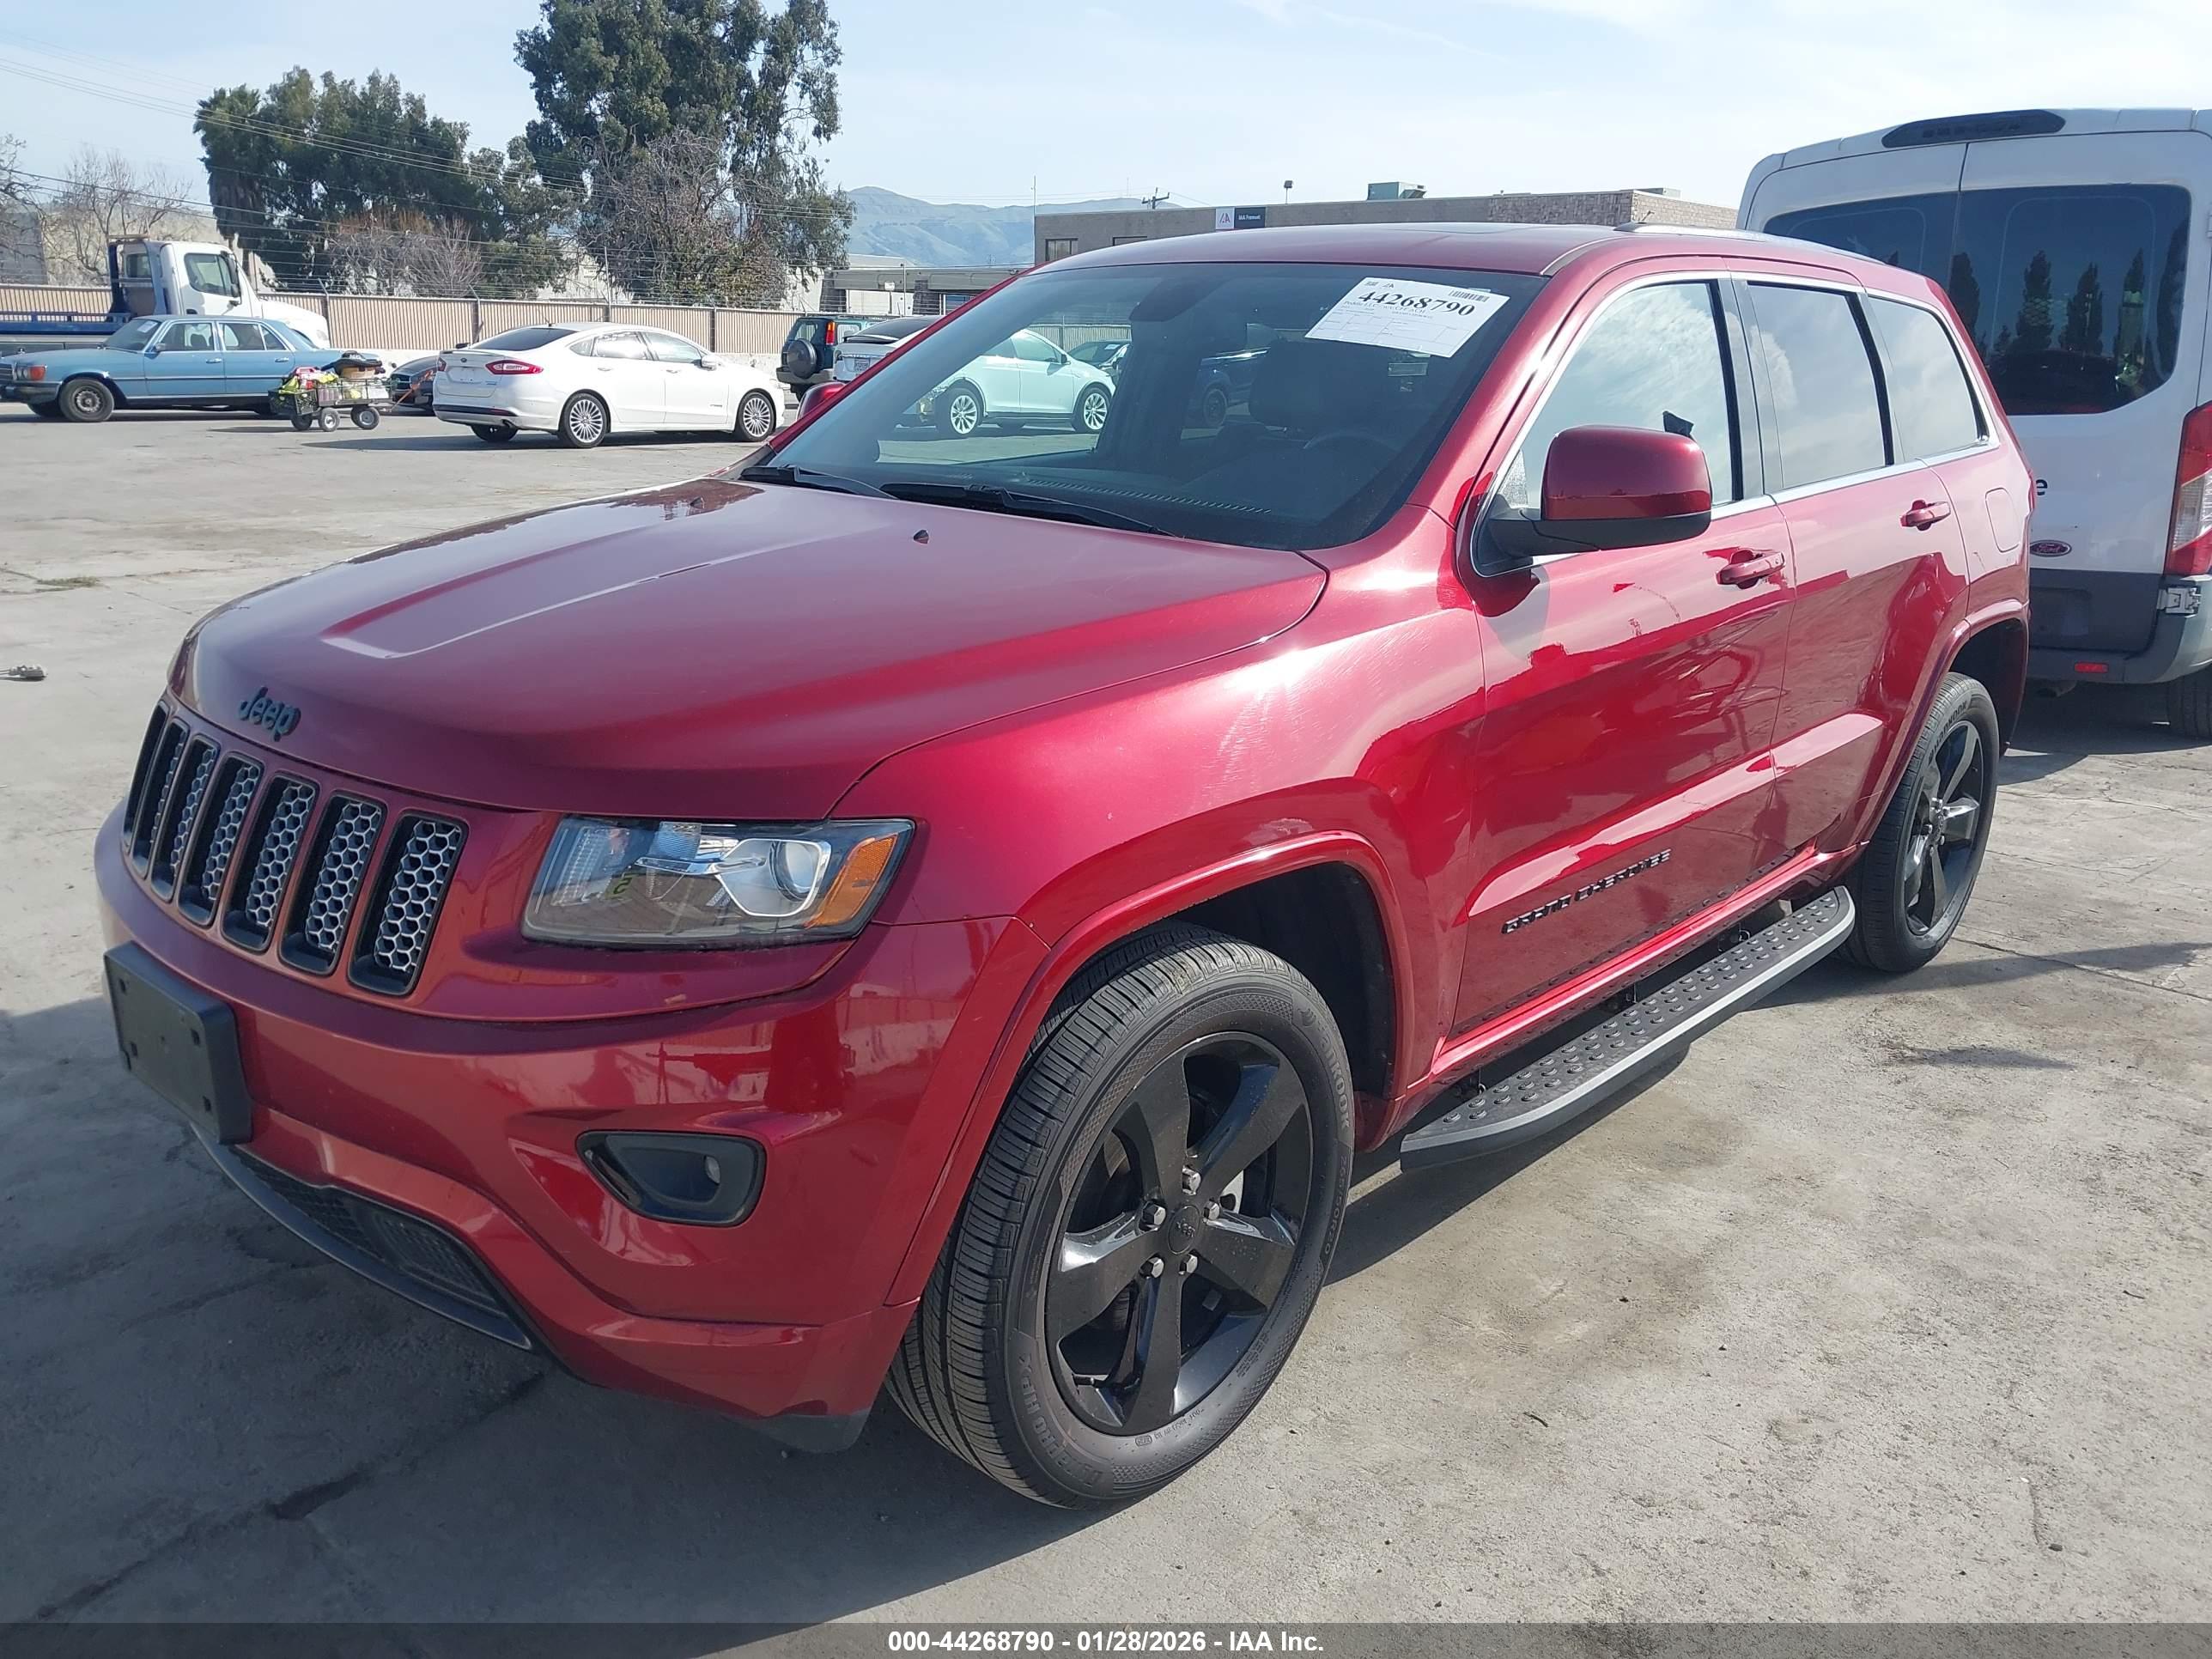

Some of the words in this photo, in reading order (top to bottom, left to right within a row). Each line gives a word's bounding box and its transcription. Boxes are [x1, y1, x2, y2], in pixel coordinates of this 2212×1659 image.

[1358, 291, 1475, 316] 44268790
[238, 686, 301, 742] Jeep
[1501, 894, 1572, 934] GRAND
[1574, 848, 1672, 902] CHEROKEE
